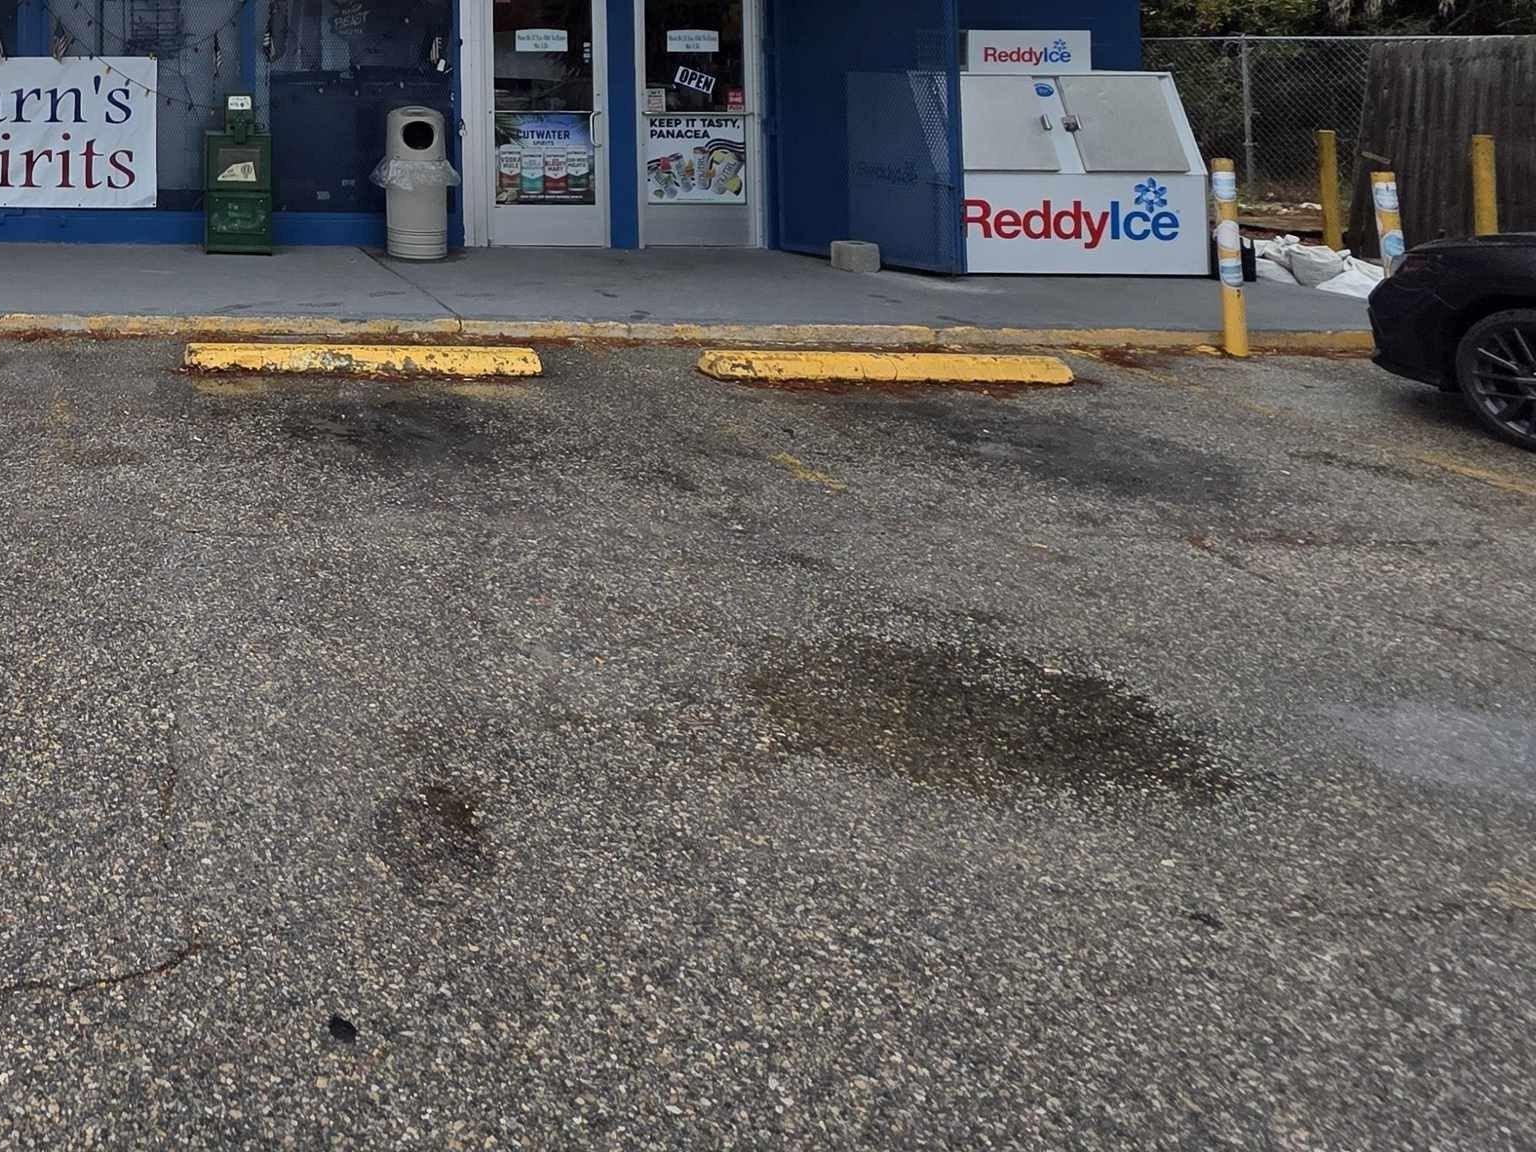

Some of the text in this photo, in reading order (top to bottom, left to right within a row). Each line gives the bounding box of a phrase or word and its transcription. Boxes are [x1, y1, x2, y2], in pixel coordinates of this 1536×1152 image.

[983, 46, 1072, 66] ReddyIce
[679, 69, 715, 94] OPEN
[650, 118, 740, 129] KEEP IT TASTY,
[518, 129, 570, 140] CUTWATER
[650, 129, 710, 139] PANACEA
[963, 199, 1180, 249] ReddyIce
